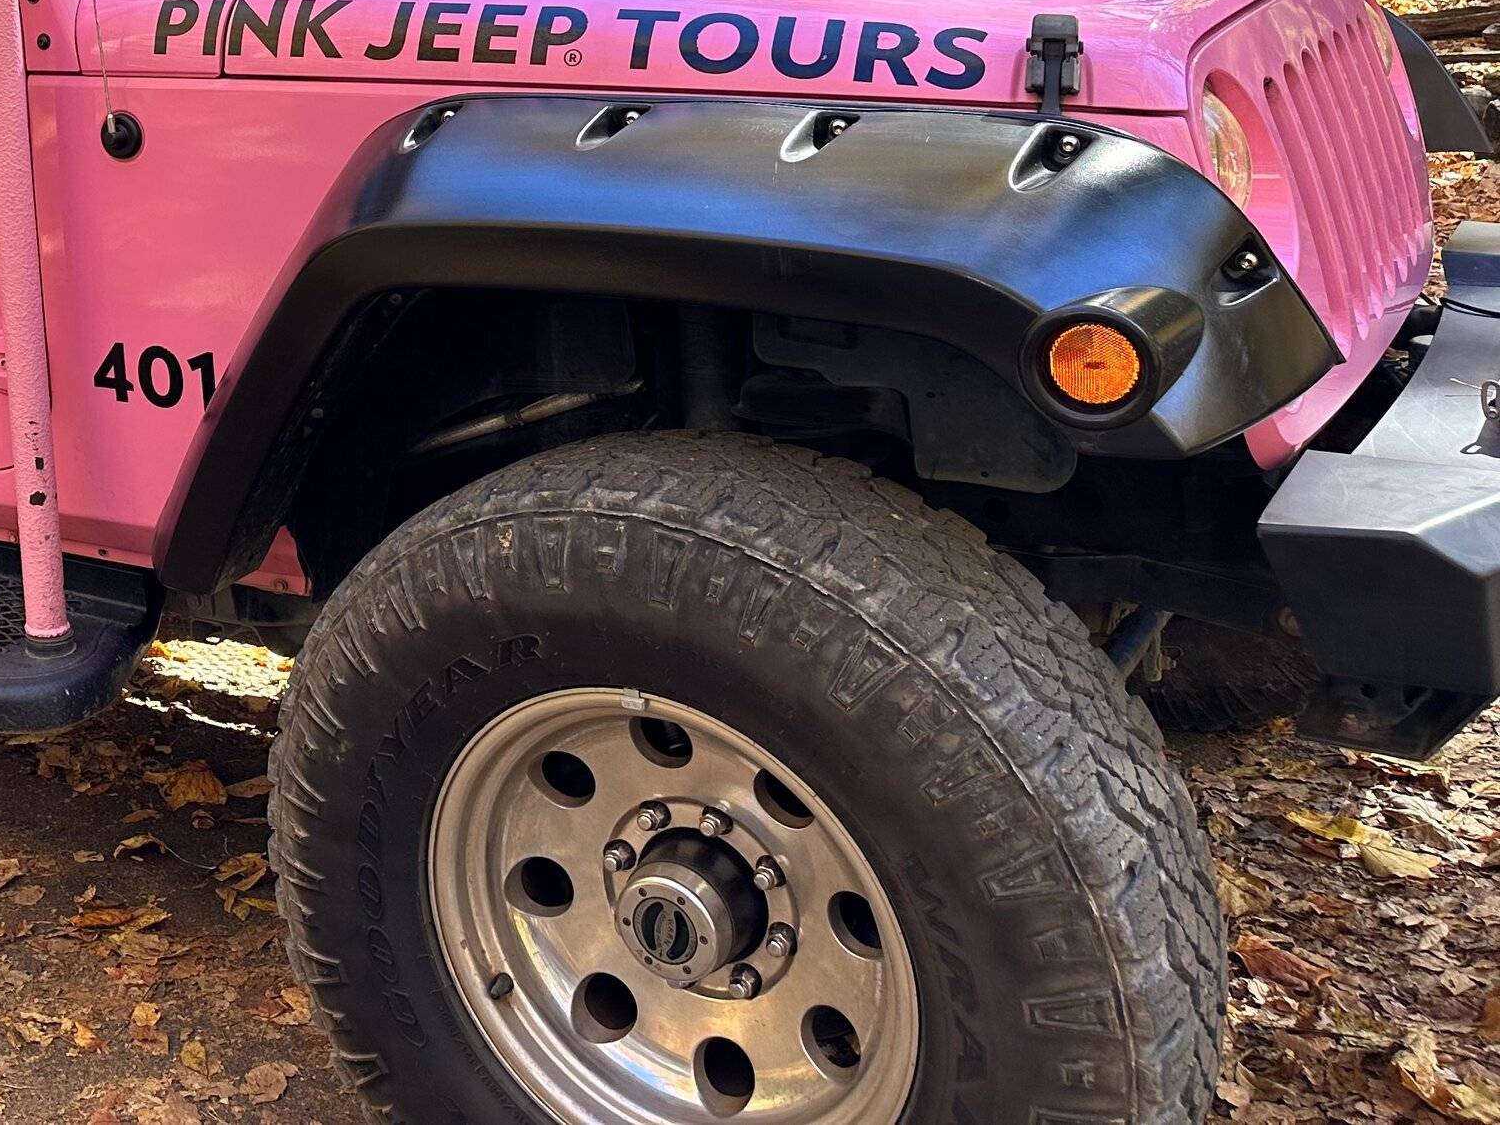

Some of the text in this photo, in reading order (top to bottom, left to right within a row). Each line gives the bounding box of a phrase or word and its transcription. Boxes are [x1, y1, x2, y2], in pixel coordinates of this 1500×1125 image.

[616, 8, 989, 90] TOURS
[93, 342, 217, 413] 401
[357, 633, 543, 1049] GOODYEAR
